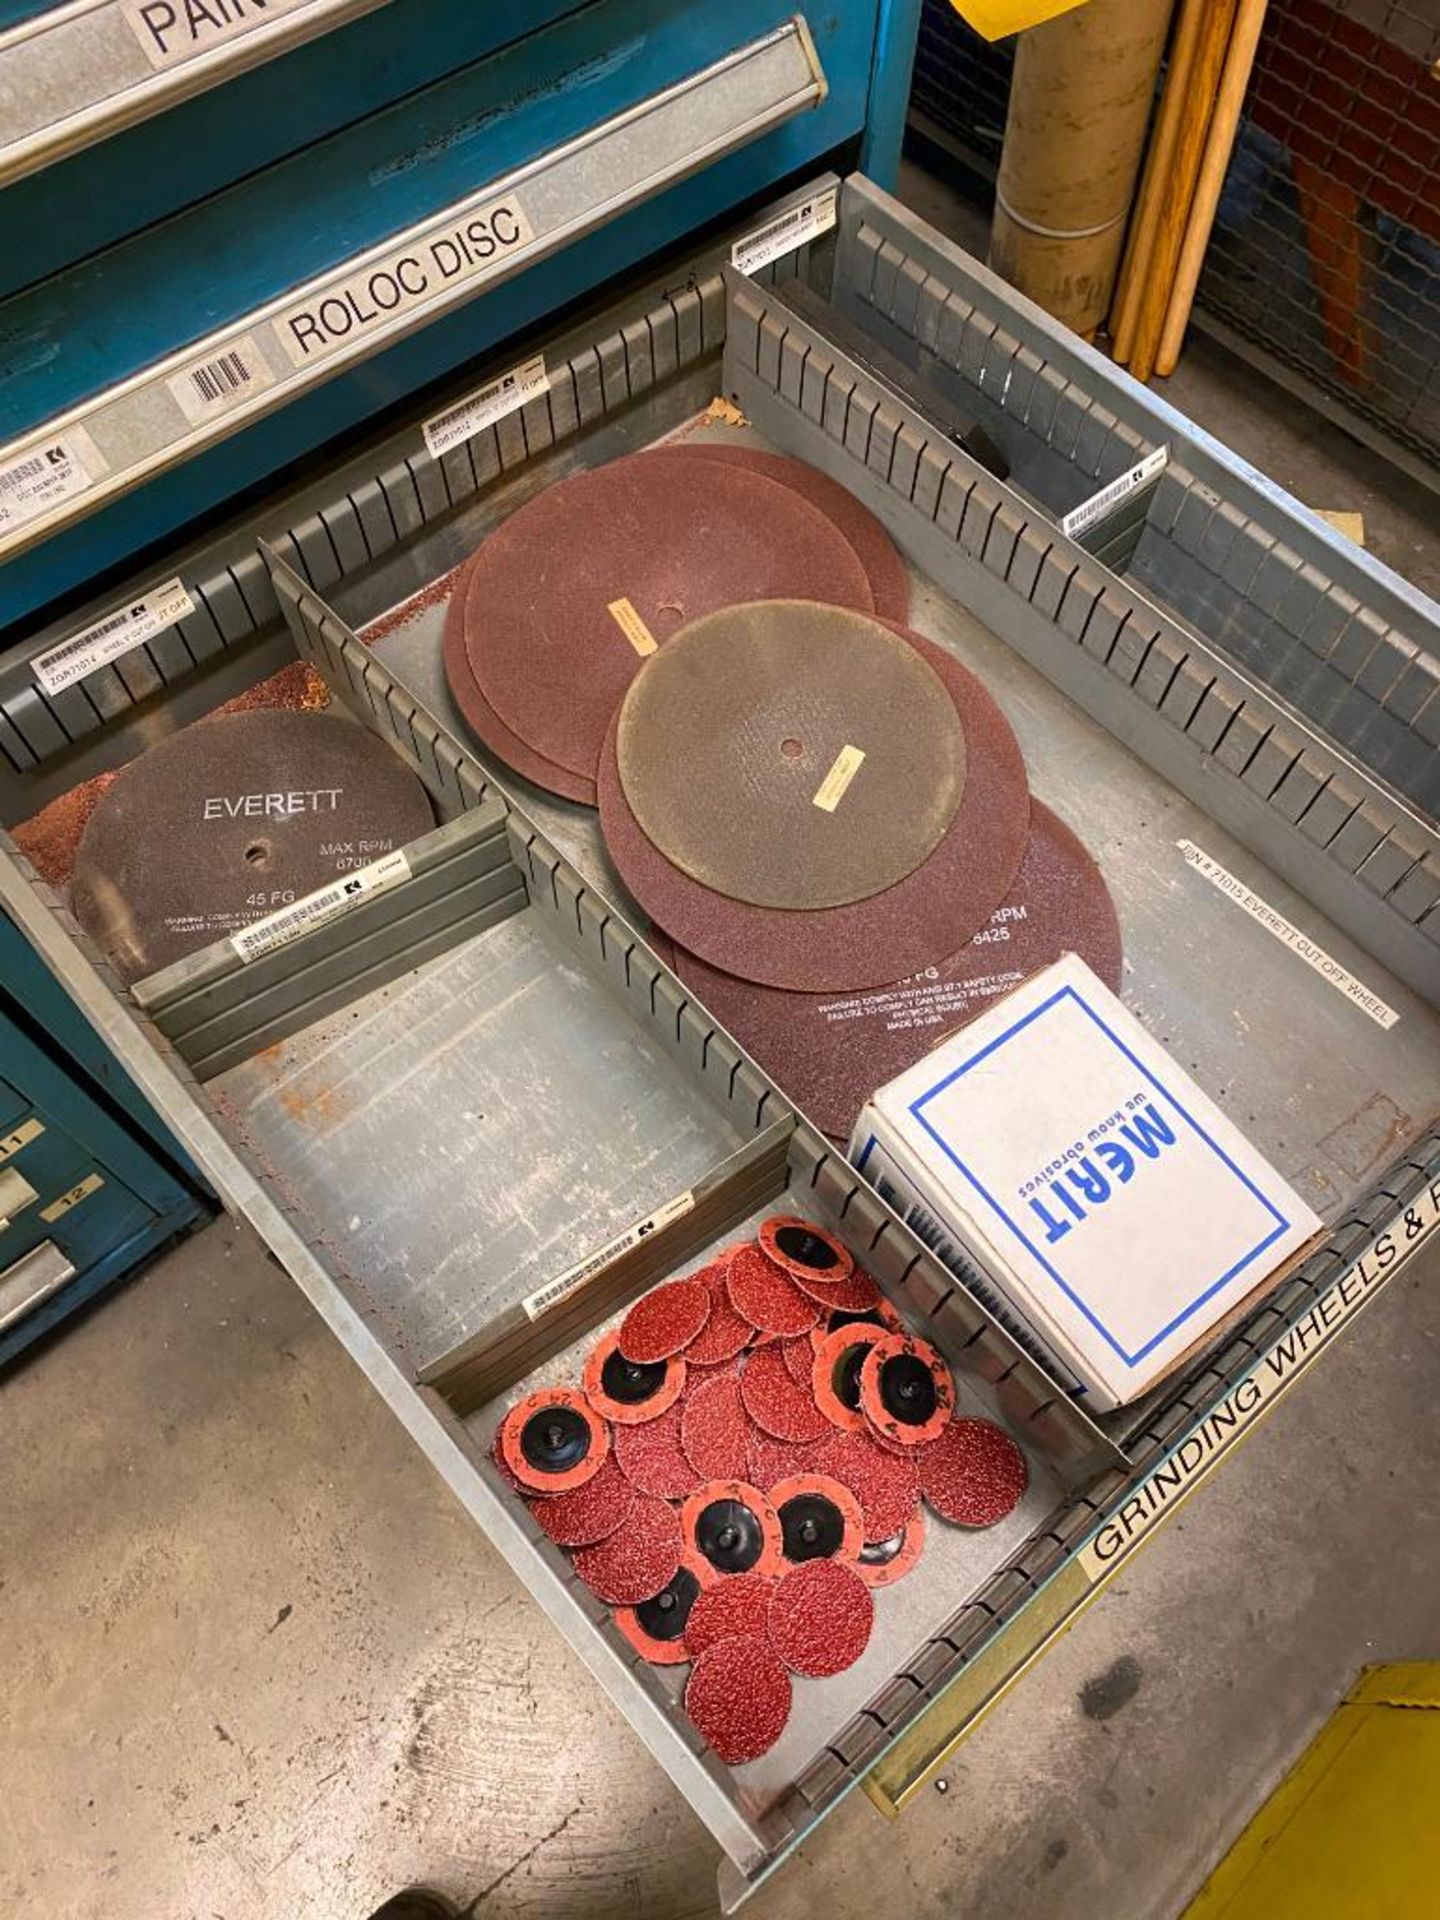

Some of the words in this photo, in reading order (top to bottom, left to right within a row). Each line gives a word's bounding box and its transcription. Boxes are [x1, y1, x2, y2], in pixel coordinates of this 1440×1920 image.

[288, 257, 428, 355] ROLOC
[430, 207, 521, 280] DISC
[203, 788, 343, 820] EVERETT
[319, 841, 354, 857] MAX
[358, 838, 393, 853] RPM
[335, 857, 372, 871] 6700
[246, 892, 266, 906] 45
[270, 889, 295, 904] FG
[1210, 868, 1244, 899] 71015
[1242, 892, 1299, 942] EVERETT
[1296, 939, 1322, 963] CUT
[1320, 958, 1350, 984] OFF
[1346, 982, 1391, 1022] WHEEL
[1124, 1092, 1147, 1111] we
[1087, 1110, 1127, 1144] know
[1017, 1140, 1085, 1199] abrasives
[1027, 1102, 1177, 1244] MERIT
[60, 1187, 88, 1206] 12
[1091, 1377, 1263, 1562] GRINDING
[1264, 1233, 1398, 1378] WHEELS
[1403, 1206, 1425, 1240] &
